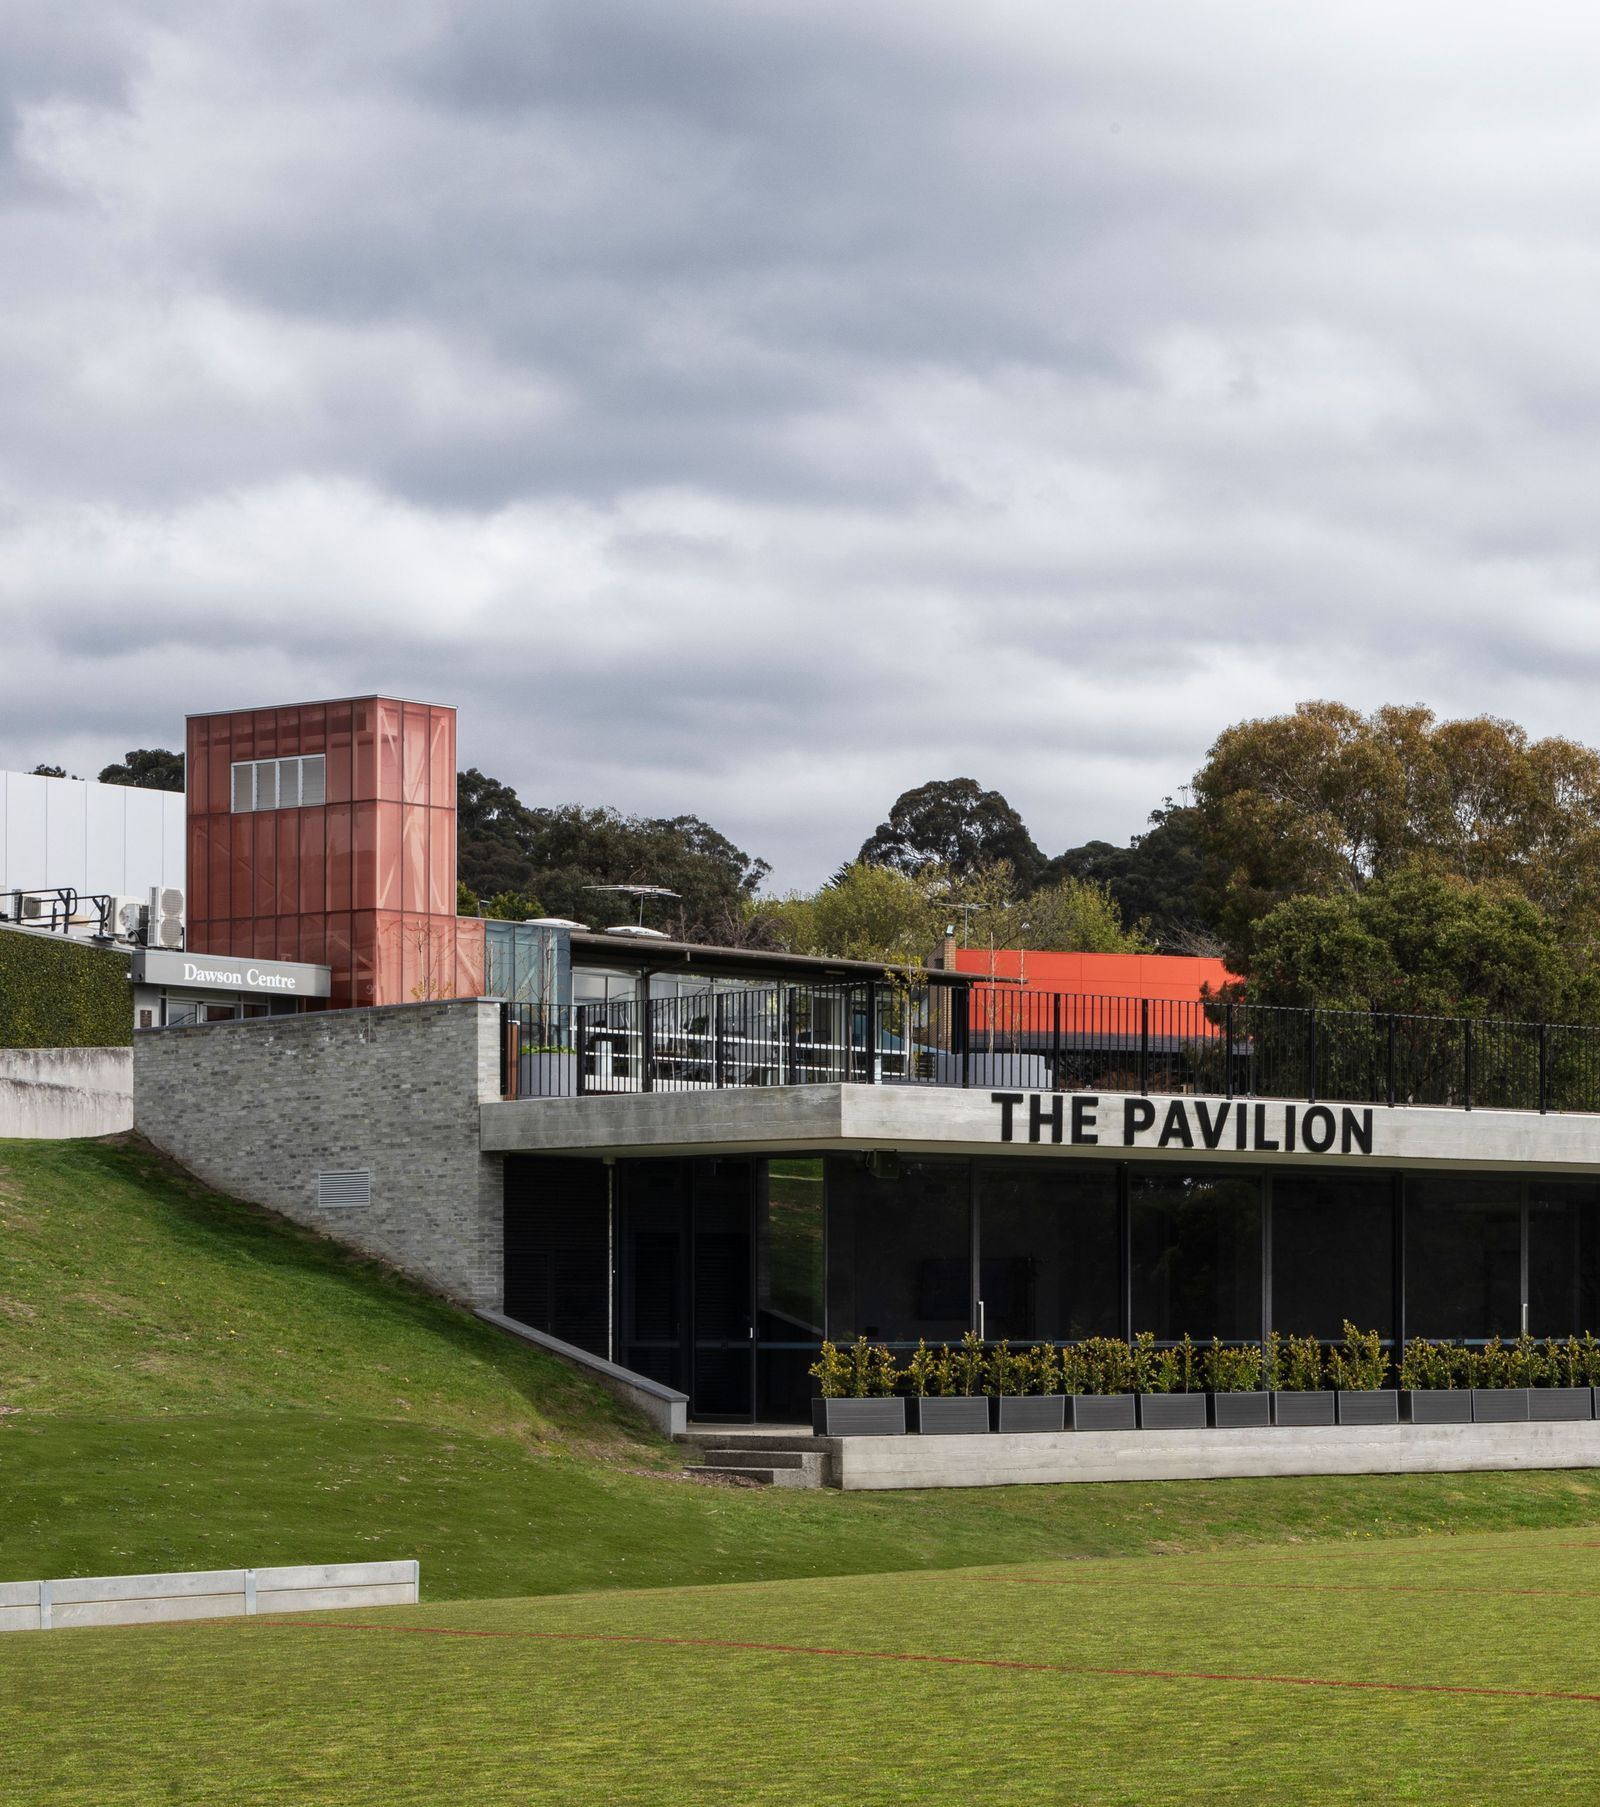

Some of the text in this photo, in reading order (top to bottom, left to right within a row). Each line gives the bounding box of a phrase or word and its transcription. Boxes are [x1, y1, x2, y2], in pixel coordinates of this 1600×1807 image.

[184, 963, 296, 989] Dawson Centre
[991, 1092, 1373, 1154] THE PAVILION
